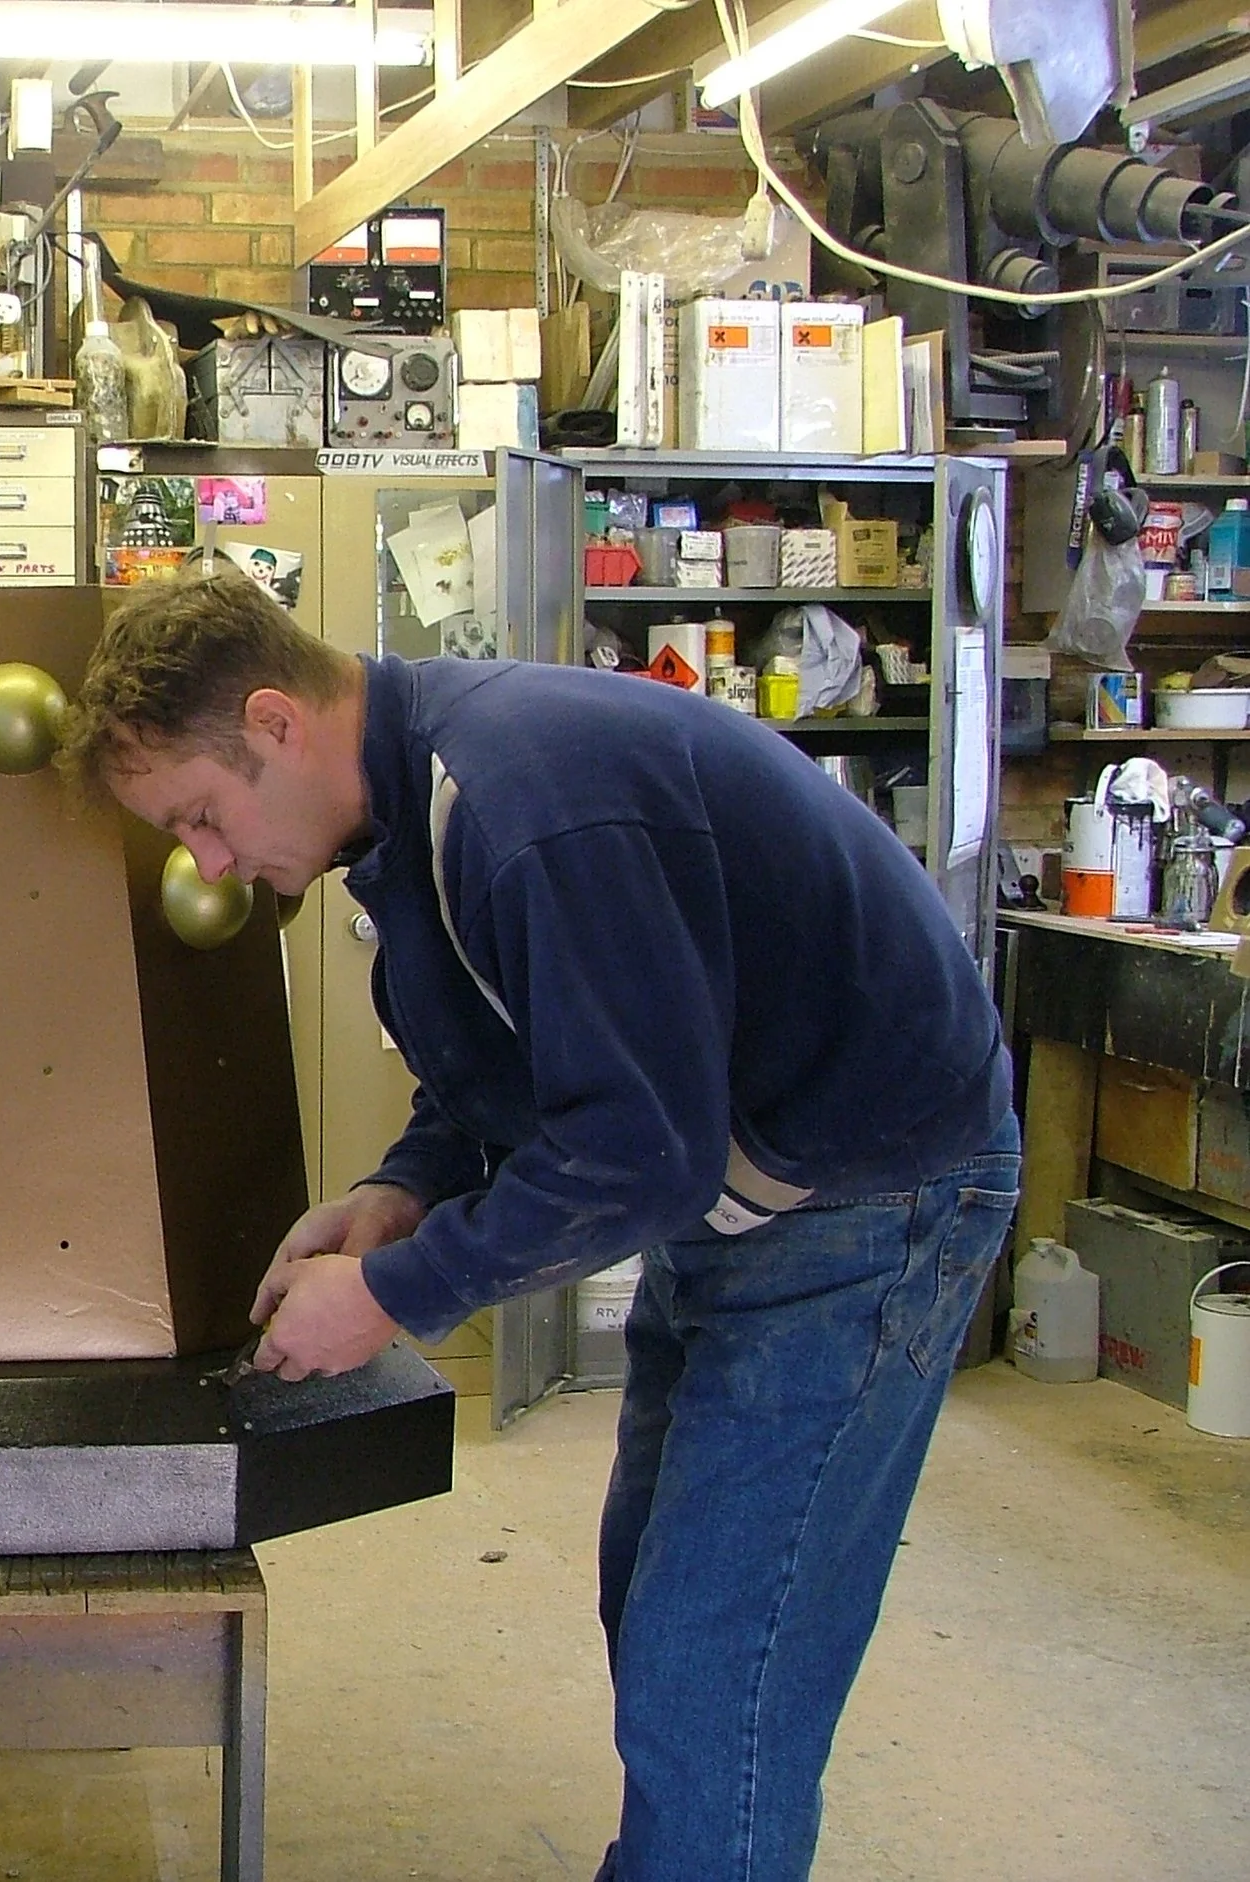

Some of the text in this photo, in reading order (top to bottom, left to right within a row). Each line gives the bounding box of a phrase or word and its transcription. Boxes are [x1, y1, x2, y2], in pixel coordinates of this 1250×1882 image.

[393, 454, 431, 466] VISUAL
[434, 454, 480, 467] EFFECTS
[16, 564, 56, 574] PARTS
